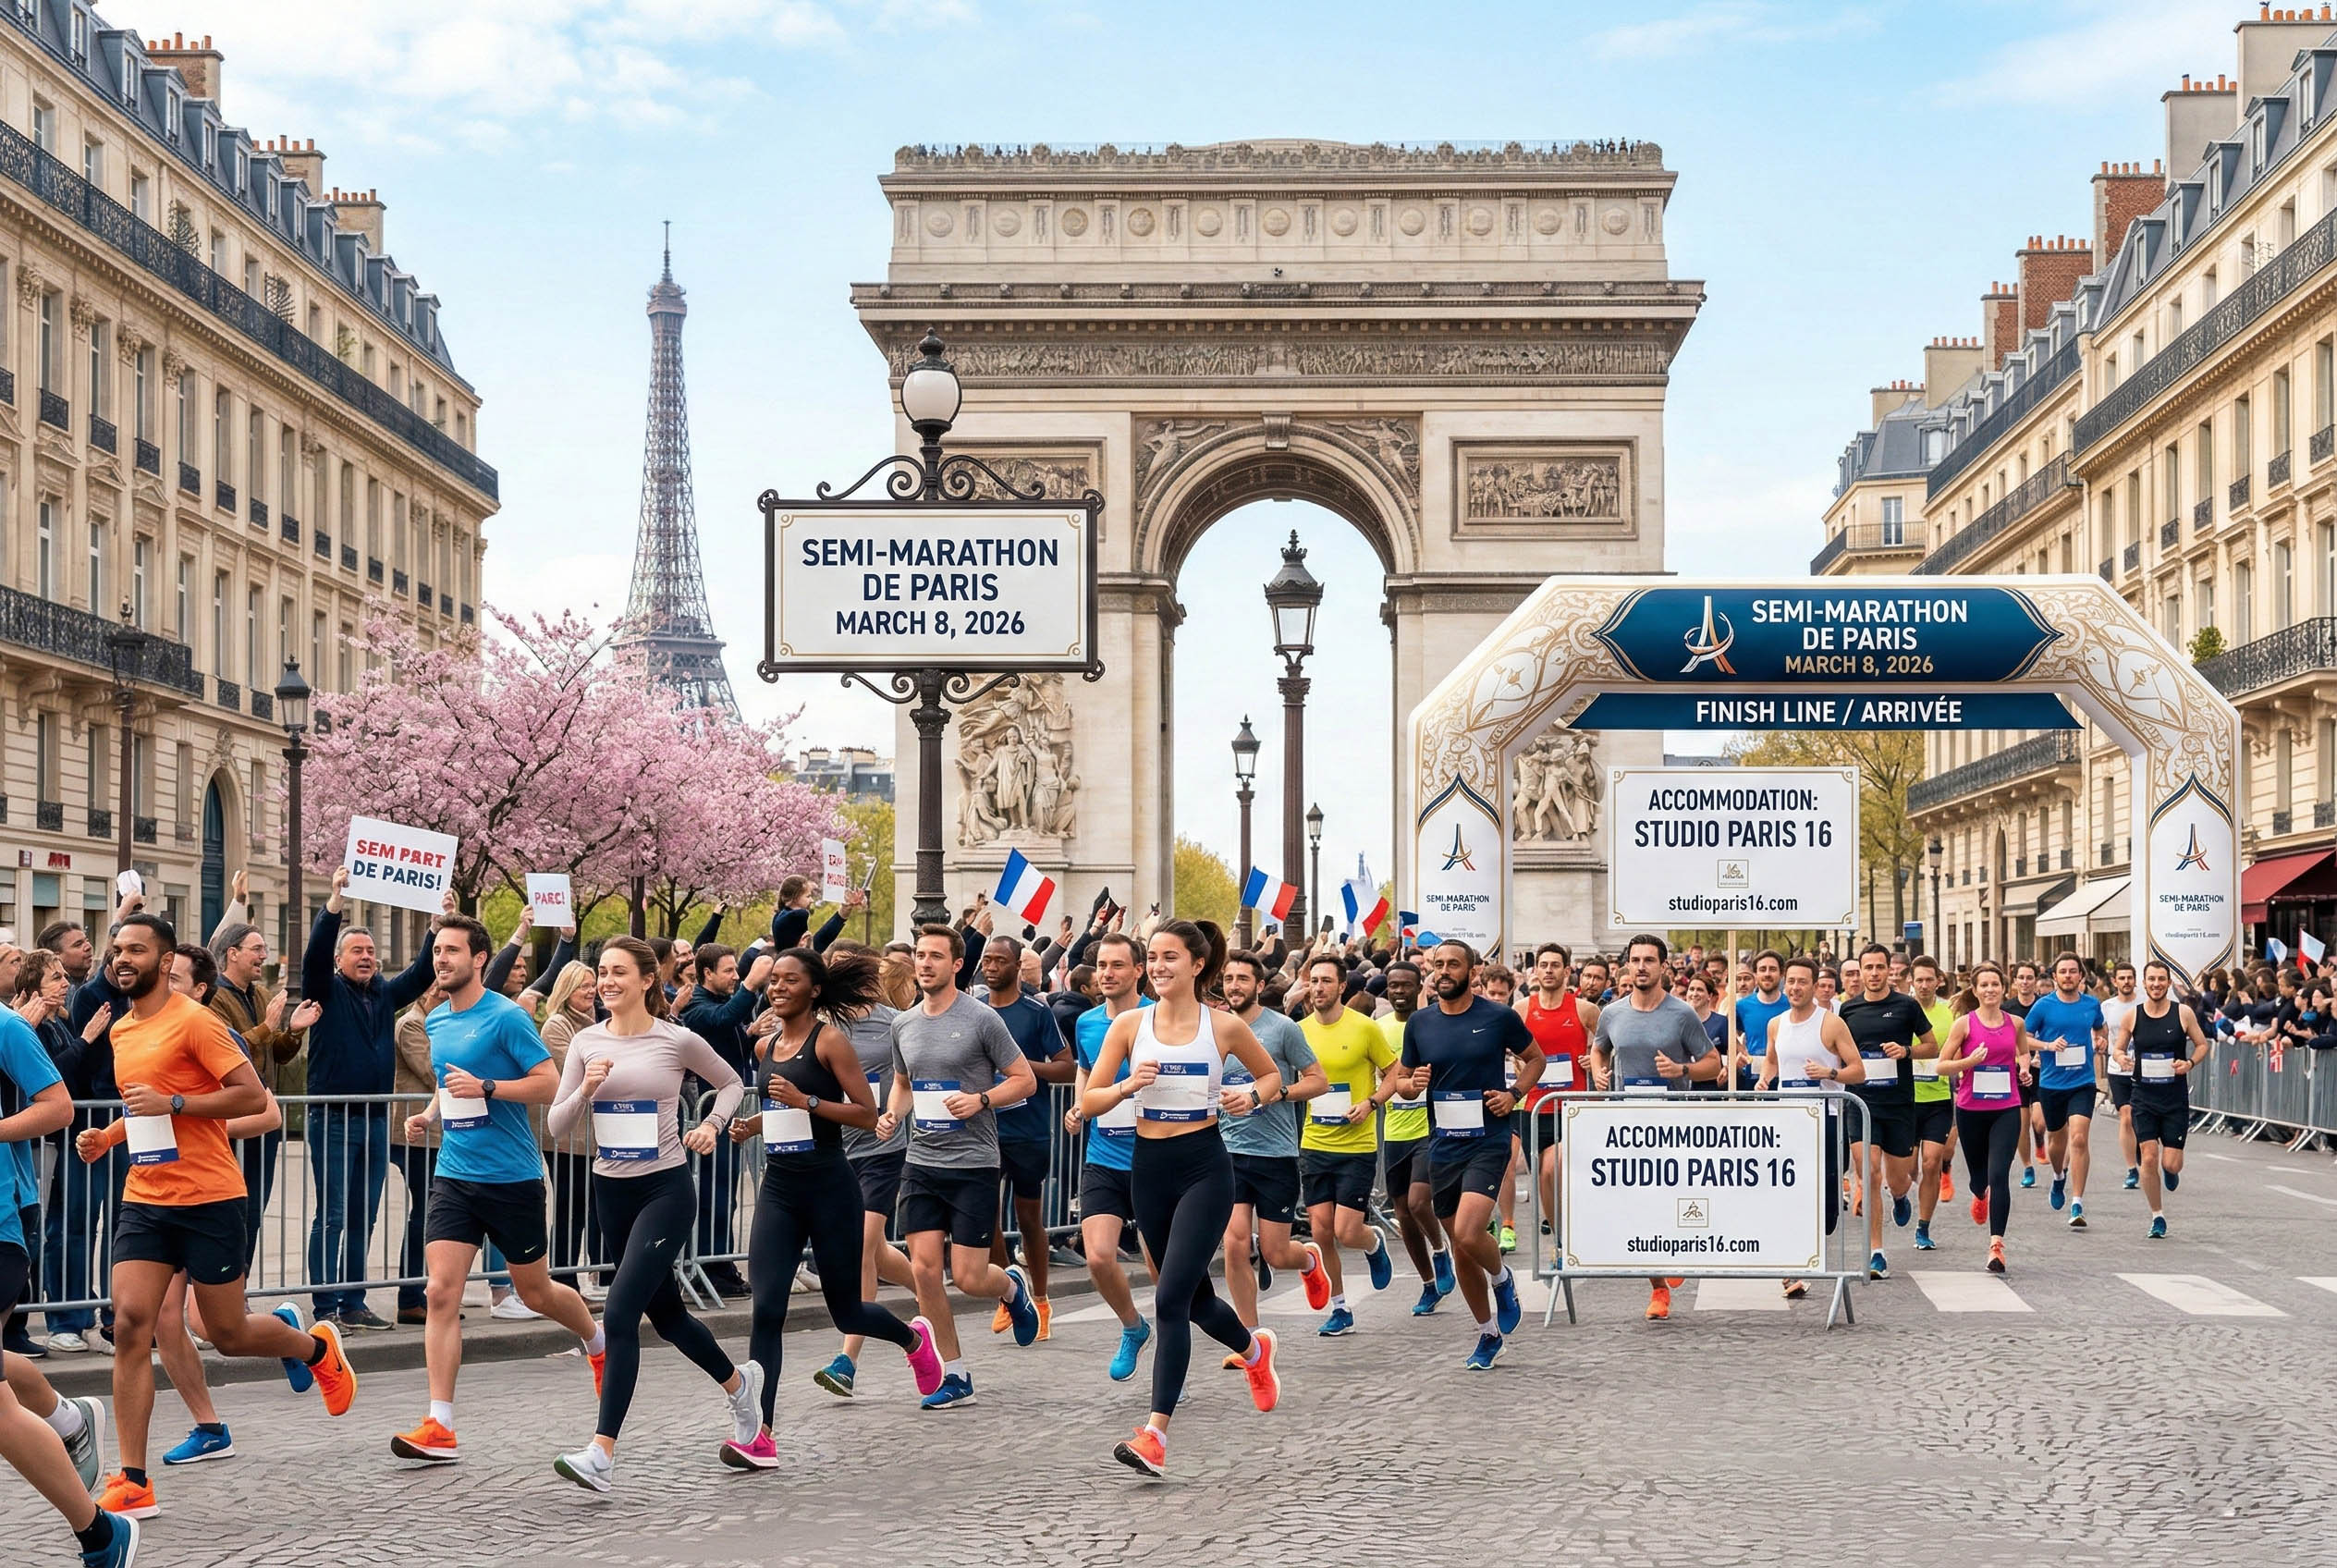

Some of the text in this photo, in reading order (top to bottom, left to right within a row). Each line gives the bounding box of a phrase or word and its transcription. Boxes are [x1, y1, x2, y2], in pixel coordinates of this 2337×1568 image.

[801, 538, 1058, 567] SEMI-MARATHON
[863, 573, 999, 602] DE PARIS
[1752, 599, 1968, 623] SEMI-MARATHON
[836, 610, 1025, 641] MARCH 8, 2026
[1803, 627, 1917, 651] DE PARIS
[1785, 655, 1934, 678] MARCH 8, 2026
[1696, 695, 1963, 725] FINISH LINE / ARRIVÉE
[1648, 789, 1818, 811] ACCOMMODATION:
[1634, 819, 1832, 848] STUDIO PARIS 16
[356, 839, 395, 860] SEM
[353, 859, 442, 891] DE PARIS!
[1440, 903, 1476, 912] DE PARIS
[1669, 894, 1798, 914] studioparis16.com
[2160, 894, 2224, 903] SEMI-MARATHON
[2174, 903, 2210, 912] DE PARIS
[1605, 1125, 1781, 1148] ACCOMMODATION:
[1591, 1158, 1796, 1187] STUDIO PARIS 16
[1627, 1234, 1760, 1257] studioparis16.com
